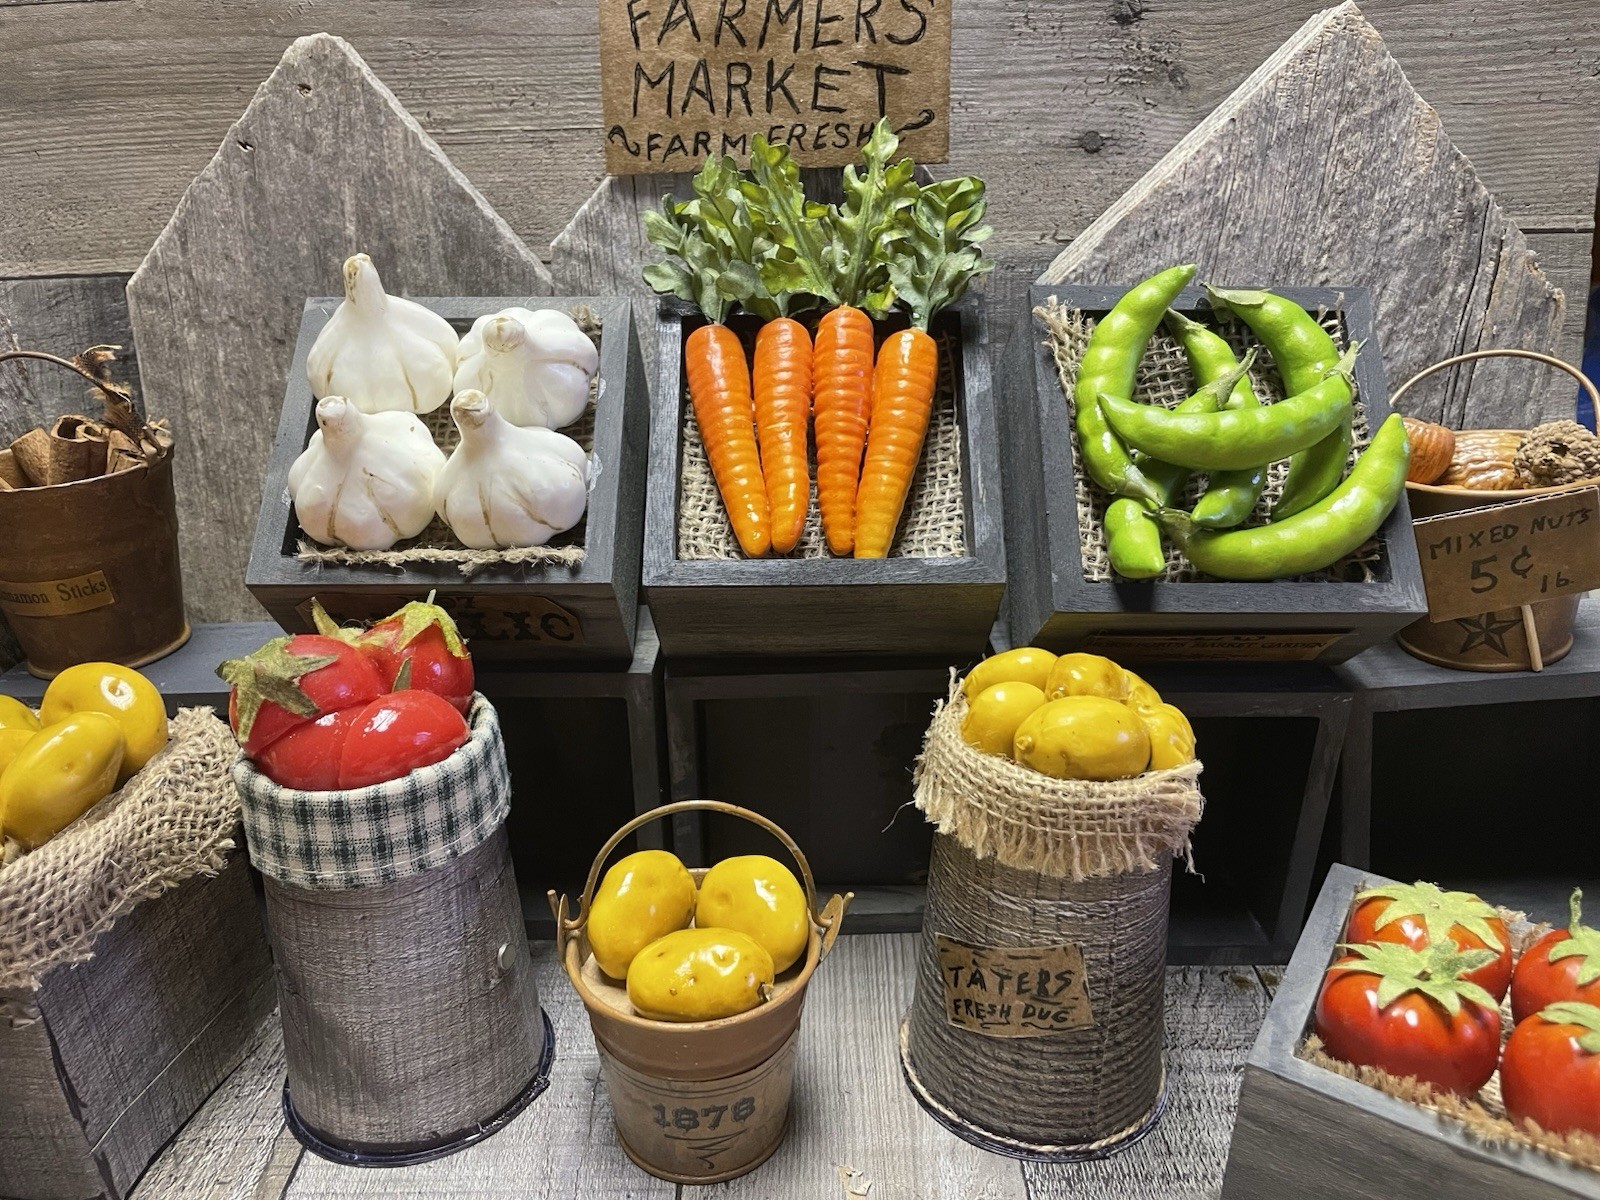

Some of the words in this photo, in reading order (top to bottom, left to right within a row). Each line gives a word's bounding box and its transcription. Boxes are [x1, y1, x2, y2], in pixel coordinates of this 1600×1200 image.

[627, 0, 934, 53] FARMERS
[632, 57, 911, 119] MARKET
[647, 130, 747, 163] FARM
[766, 122, 876, 151] FRESH
[1429, 523, 1519, 560] MIXED
[1529, 507, 1593, 534] NUTS
[56, 578, 107, 602] Sticks
[948, 966, 1075, 996] TATERS
[953, 999, 1012, 1020] FRESH
[1022, 1003, 1071, 1023] DUG
